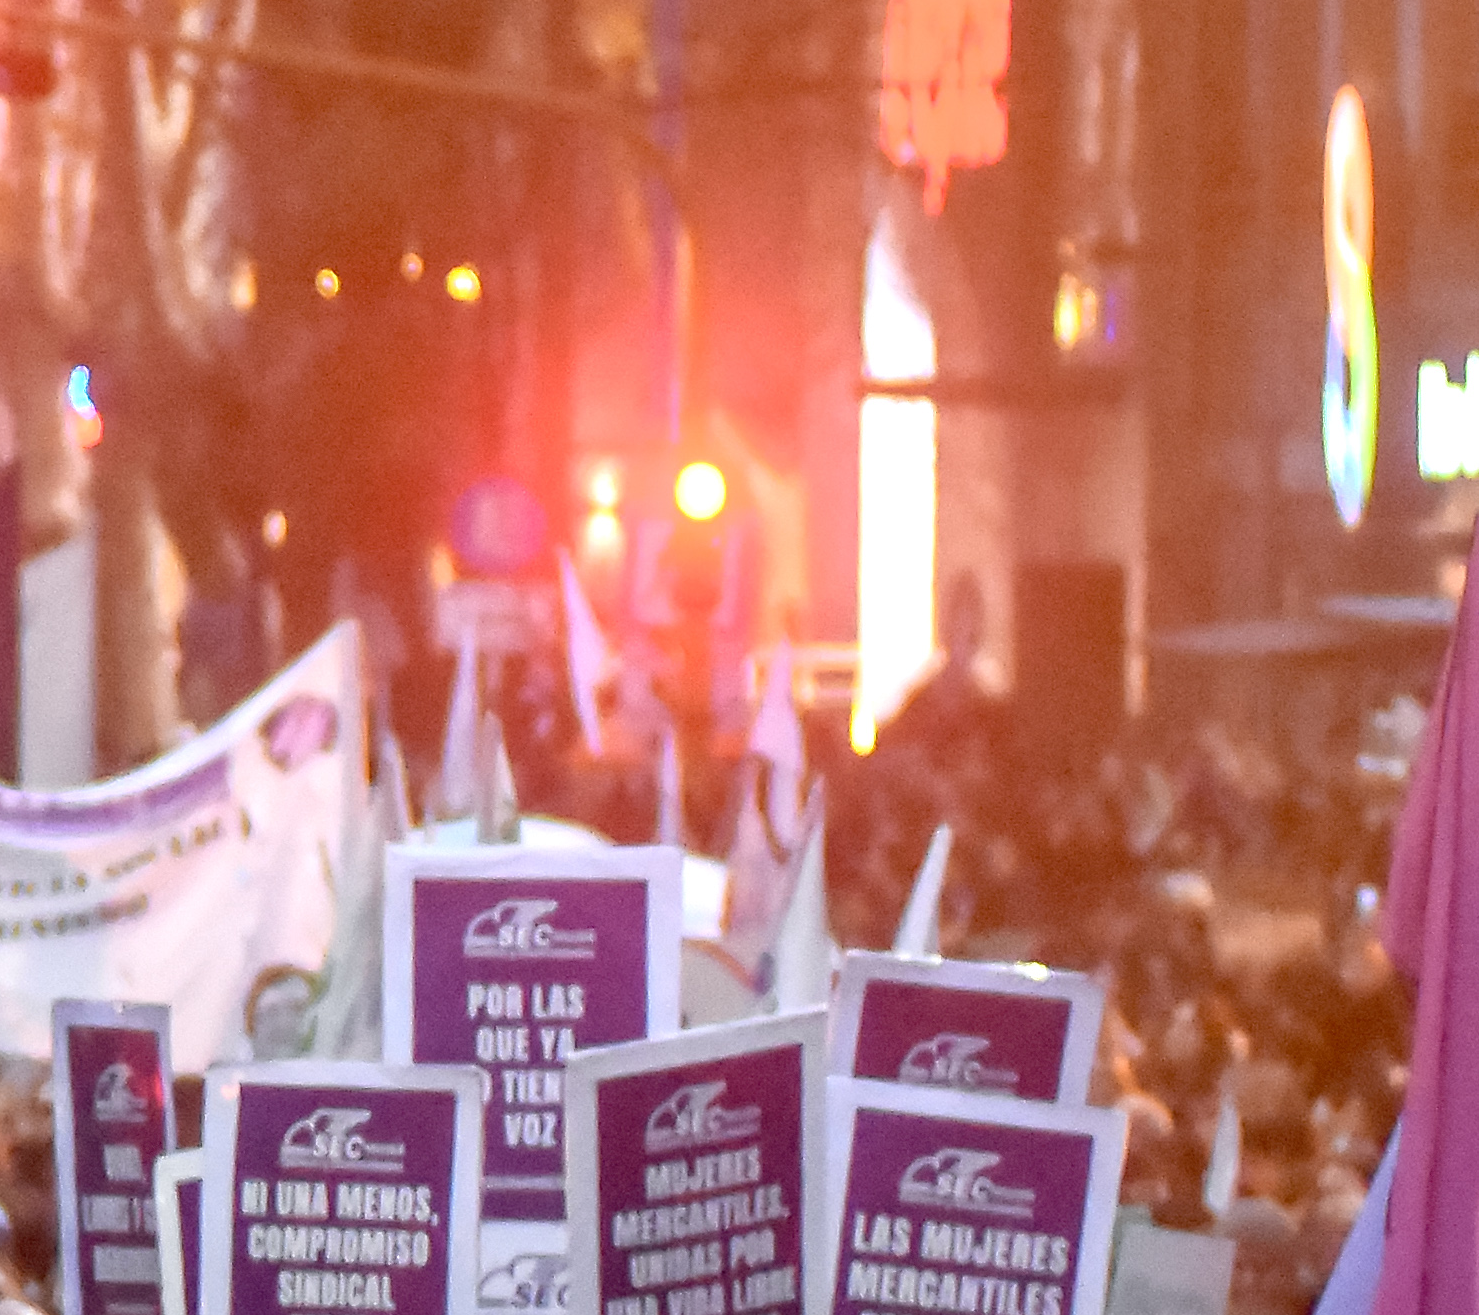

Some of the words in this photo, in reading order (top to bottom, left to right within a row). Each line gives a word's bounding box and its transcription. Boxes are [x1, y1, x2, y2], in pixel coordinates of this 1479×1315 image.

[467, 984, 526, 1020] POR
[532, 985, 585, 1021] LAS
[476, 1027, 530, 1063] QUE
[503, 1113, 558, 1148] VOZ
[643, 1147, 762, 1201] MUJERES
[241, 1180, 268, 1216] NI
[276, 1179, 330, 1219] UNA
[247, 1225, 430, 1267] COMPROMISO
[853, 1212, 912, 1257] LAS
[920, 1221, 1070, 1277] MUJERES
[277, 1270, 396, 1312] SINDICAL
